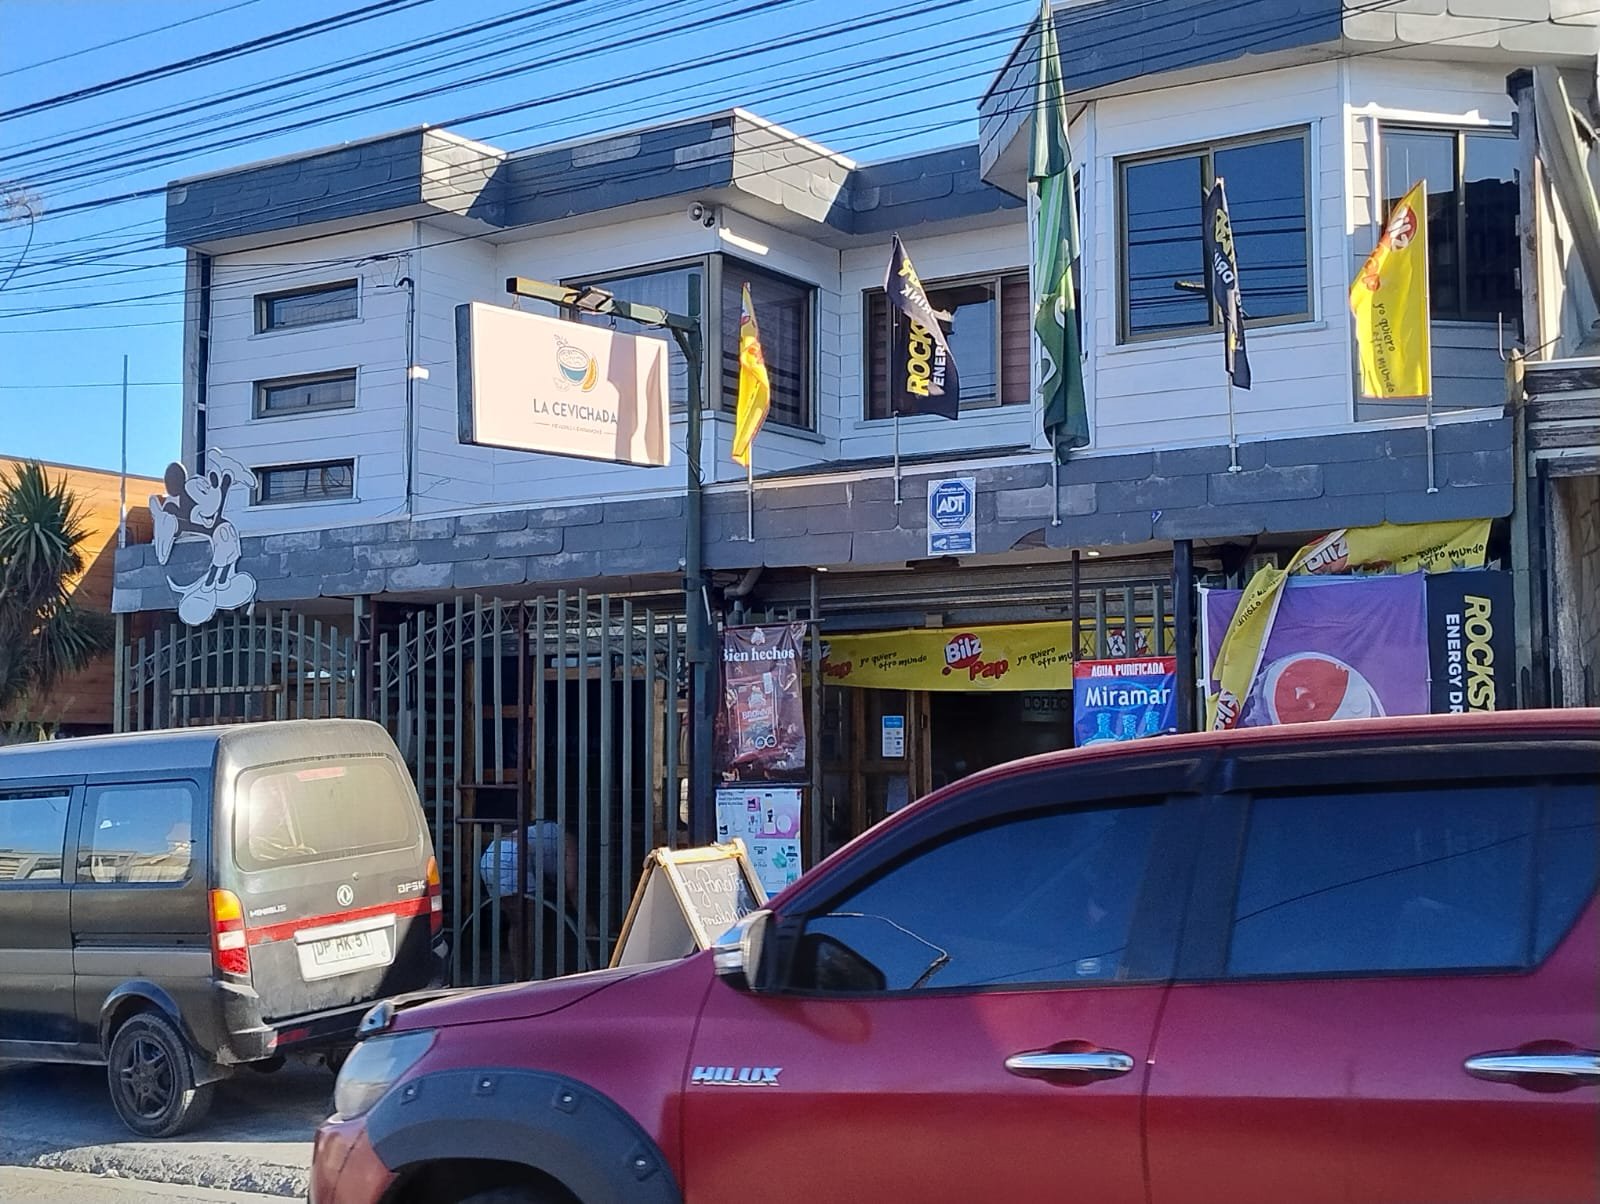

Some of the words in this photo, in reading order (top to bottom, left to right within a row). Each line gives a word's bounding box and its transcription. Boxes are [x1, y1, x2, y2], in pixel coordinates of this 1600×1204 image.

[533, 398, 550, 415] LA
[552, 401, 618, 425] CEVICHADA
[937, 495, 966, 514] ADT
[1448, 543, 1485, 559] mundo
[751, 646, 795, 661] hechos
[944, 637, 983, 664] Bilz
[1445, 613, 1463, 688] ENERGY
[1464, 595, 1496, 713] ROCKS
[1091, 664, 1114, 677] AGUA
[1115, 662, 1165, 677] PURIFICADA
[1085, 687, 1171, 707] Miramar
[397, 879, 426, 894] DFSK
[691, 1066, 783, 1085] HILUX
